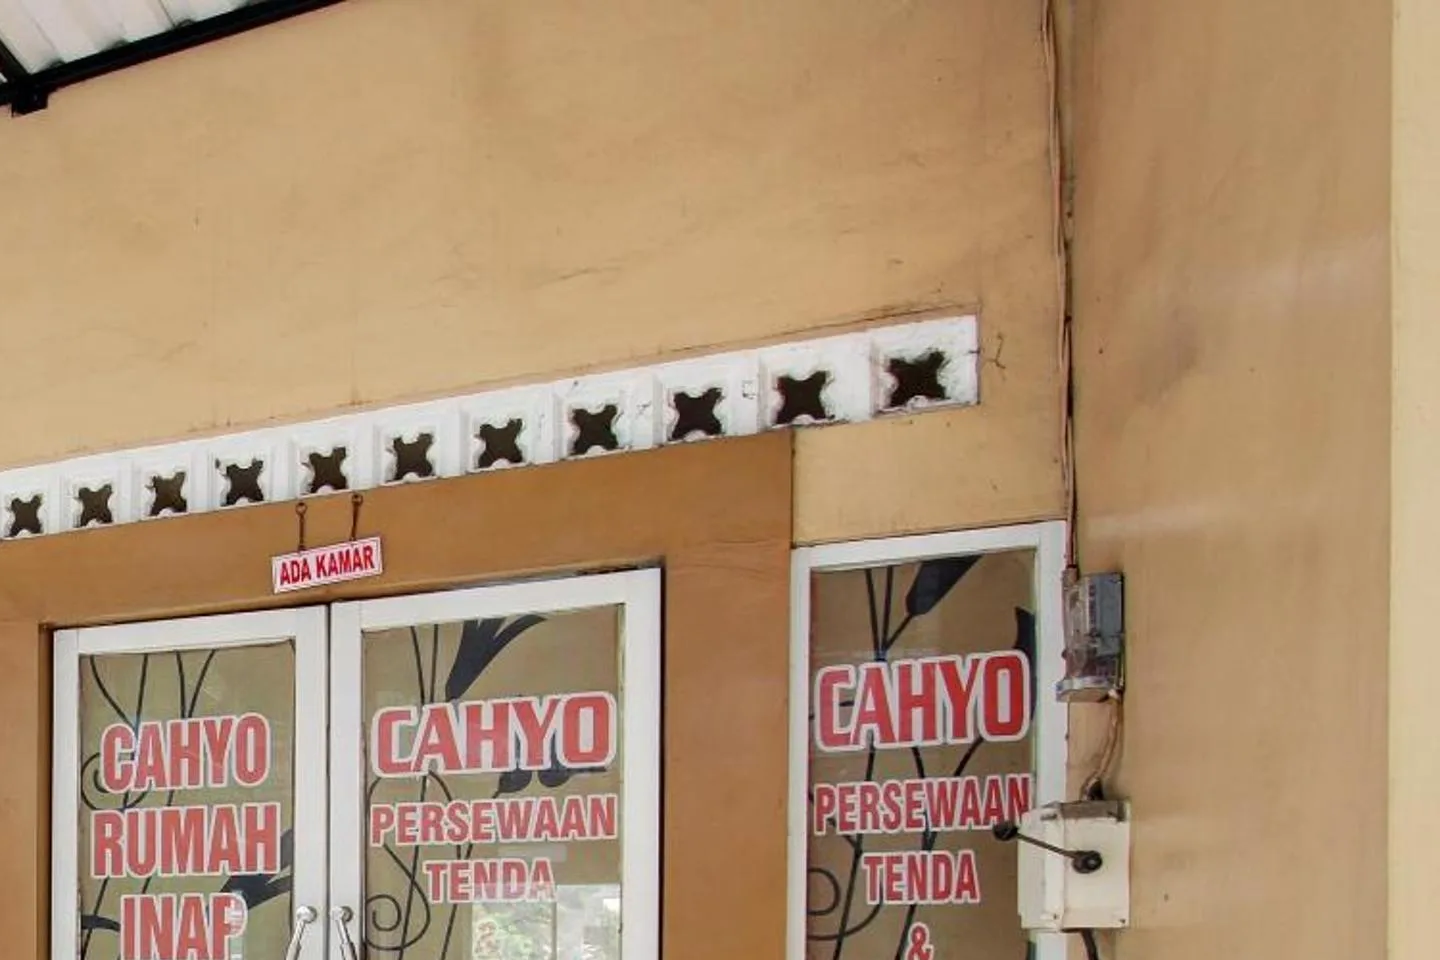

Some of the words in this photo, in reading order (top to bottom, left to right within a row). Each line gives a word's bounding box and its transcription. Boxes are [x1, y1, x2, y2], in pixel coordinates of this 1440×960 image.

[280, 558, 311, 585] ADA
[316, 545, 375, 578] KAMAR
[817, 650, 1031, 752] CAHYO
[101, 712, 271, 794] CAHYO
[371, 691, 617, 777] CAHYO
[369, 794, 618, 847] PERSEWAAN
[814, 773, 1033, 835] PERSEWAAN
[90, 802, 281, 878] RUMAH
[423, 857, 556, 904] TENDA
[862, 850, 980, 905] TENDA
